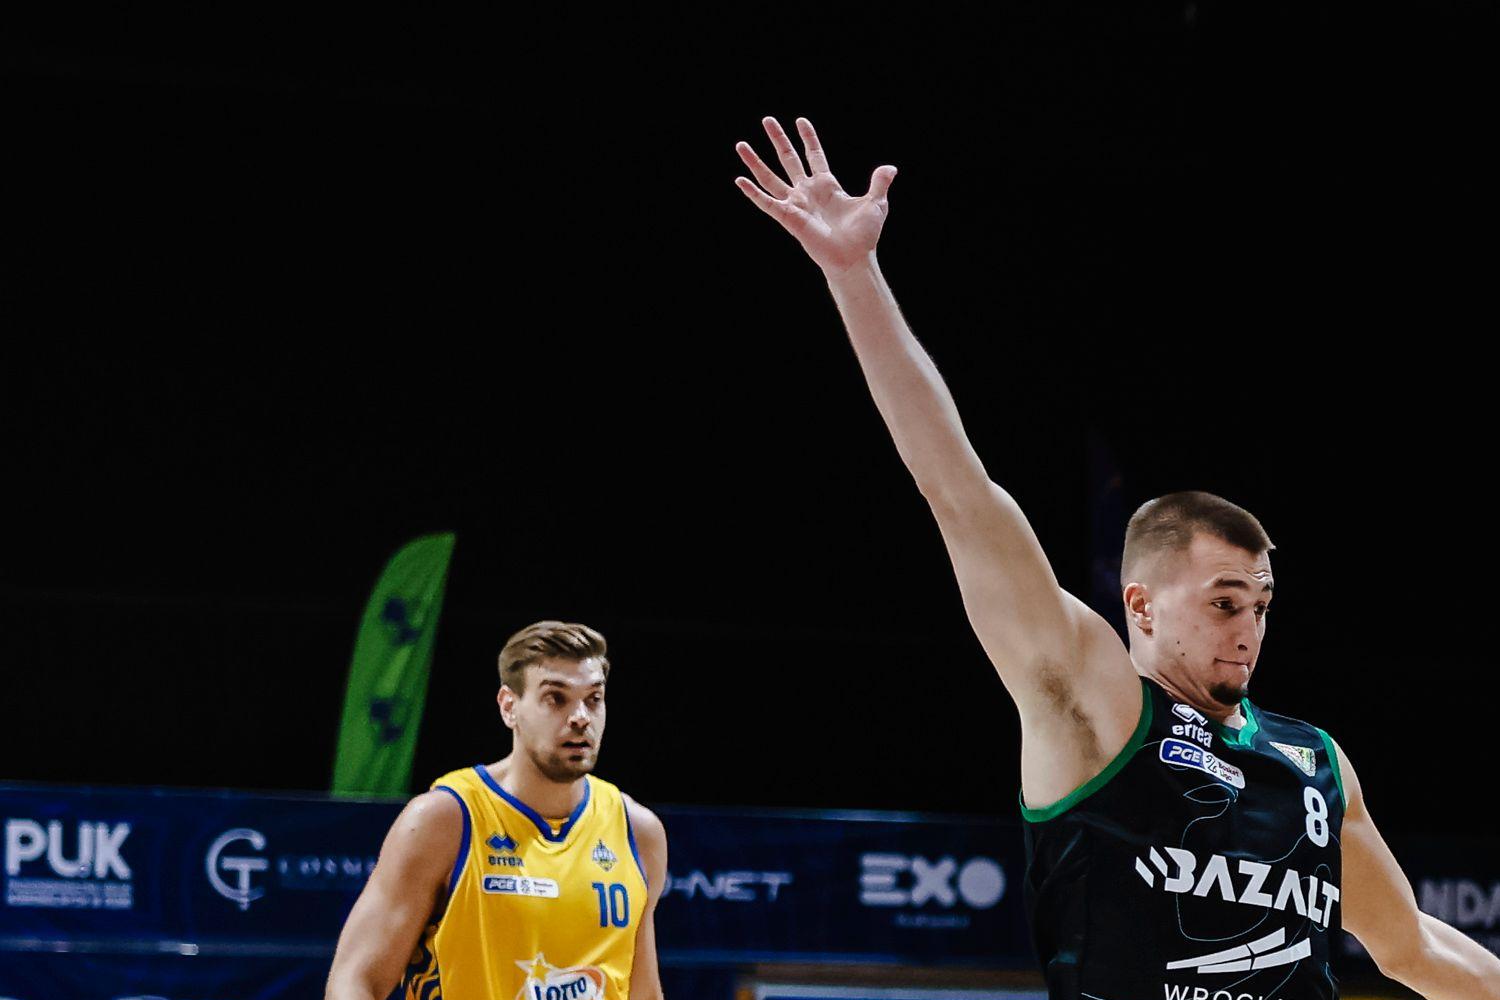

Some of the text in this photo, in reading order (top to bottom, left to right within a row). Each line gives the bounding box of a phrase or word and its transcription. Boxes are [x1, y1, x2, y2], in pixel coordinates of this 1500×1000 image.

[1169, 745, 1202, 763] PGE
[1303, 786, 1329, 848] 8
[5, 818, 133, 881] PUK
[592, 882, 630, 928] 10
[1162, 846, 1340, 929] BAZALT
